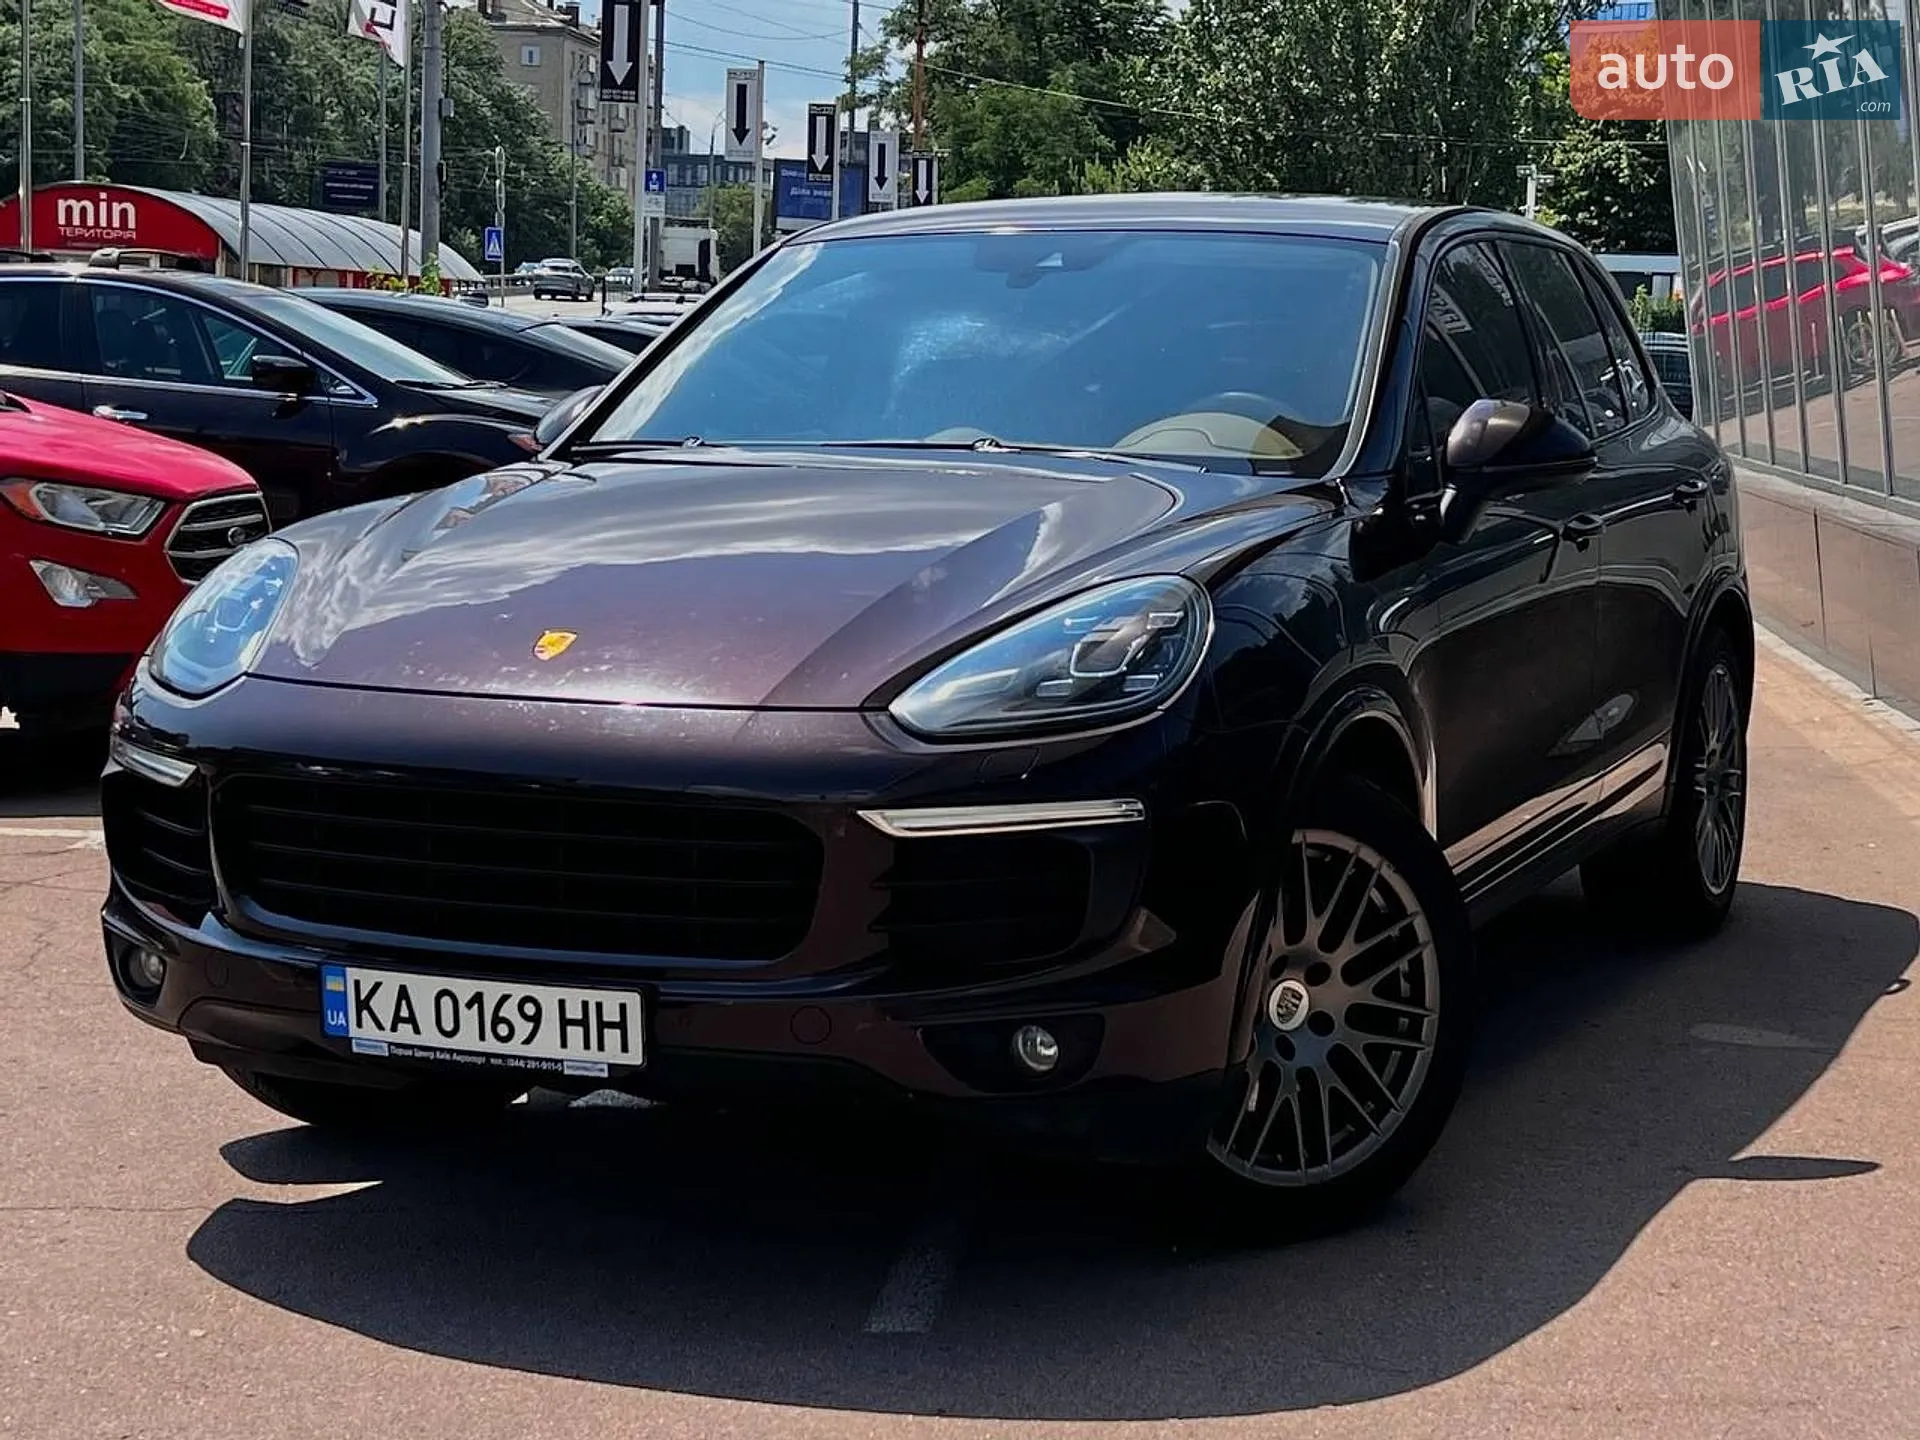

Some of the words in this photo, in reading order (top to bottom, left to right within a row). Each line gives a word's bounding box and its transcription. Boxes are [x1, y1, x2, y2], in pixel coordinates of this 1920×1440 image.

[57, 191, 136, 230] min
[58, 226, 136, 240] ТЕРИТОРІЯ
[327, 1010, 348, 1028] UA
[353, 979, 421, 1036] KA
[434, 988, 543, 1045] 0169
[558, 998, 629, 1054] HH
